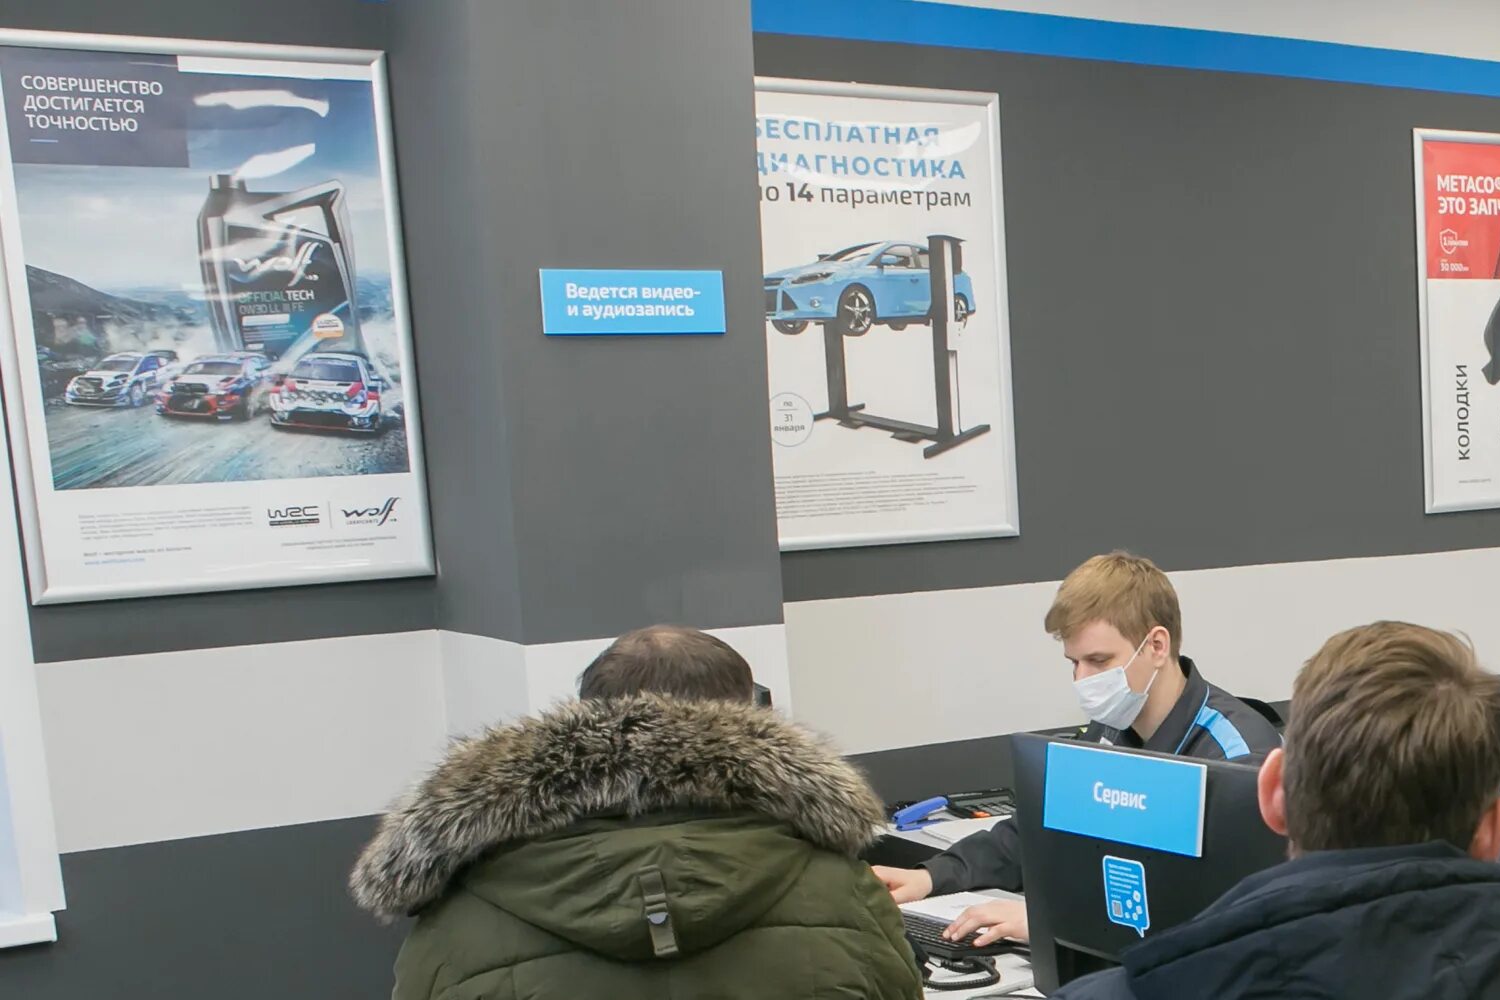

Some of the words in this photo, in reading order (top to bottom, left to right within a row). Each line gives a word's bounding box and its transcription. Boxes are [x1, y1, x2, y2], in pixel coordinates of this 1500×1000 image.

[21, 75, 163, 96] СОВЕРШЕНСТВО
[24, 95, 145, 114] ДОСТИГАЕТСЯ
[25, 114, 138, 133] ТОЧНОСТЬЮ
[759, 185, 780, 202] о
[786, 182, 814, 202] 14
[821, 187, 971, 211] параметрам
[1438, 196, 1466, 215] ЭТО
[565, 283, 637, 302] Ведется
[641, 285, 701, 302] видео-
[567, 304, 578, 316] и
[581, 303, 695, 321] аудиозапись
[783, 400, 793, 408] по
[1456, 364, 1471, 460] КОЛОДКИ
[784, 414, 793, 423] 31
[774, 425, 805, 434] января
[268, 505, 319, 519] WRC
[1093, 781, 1147, 810] Сервис
